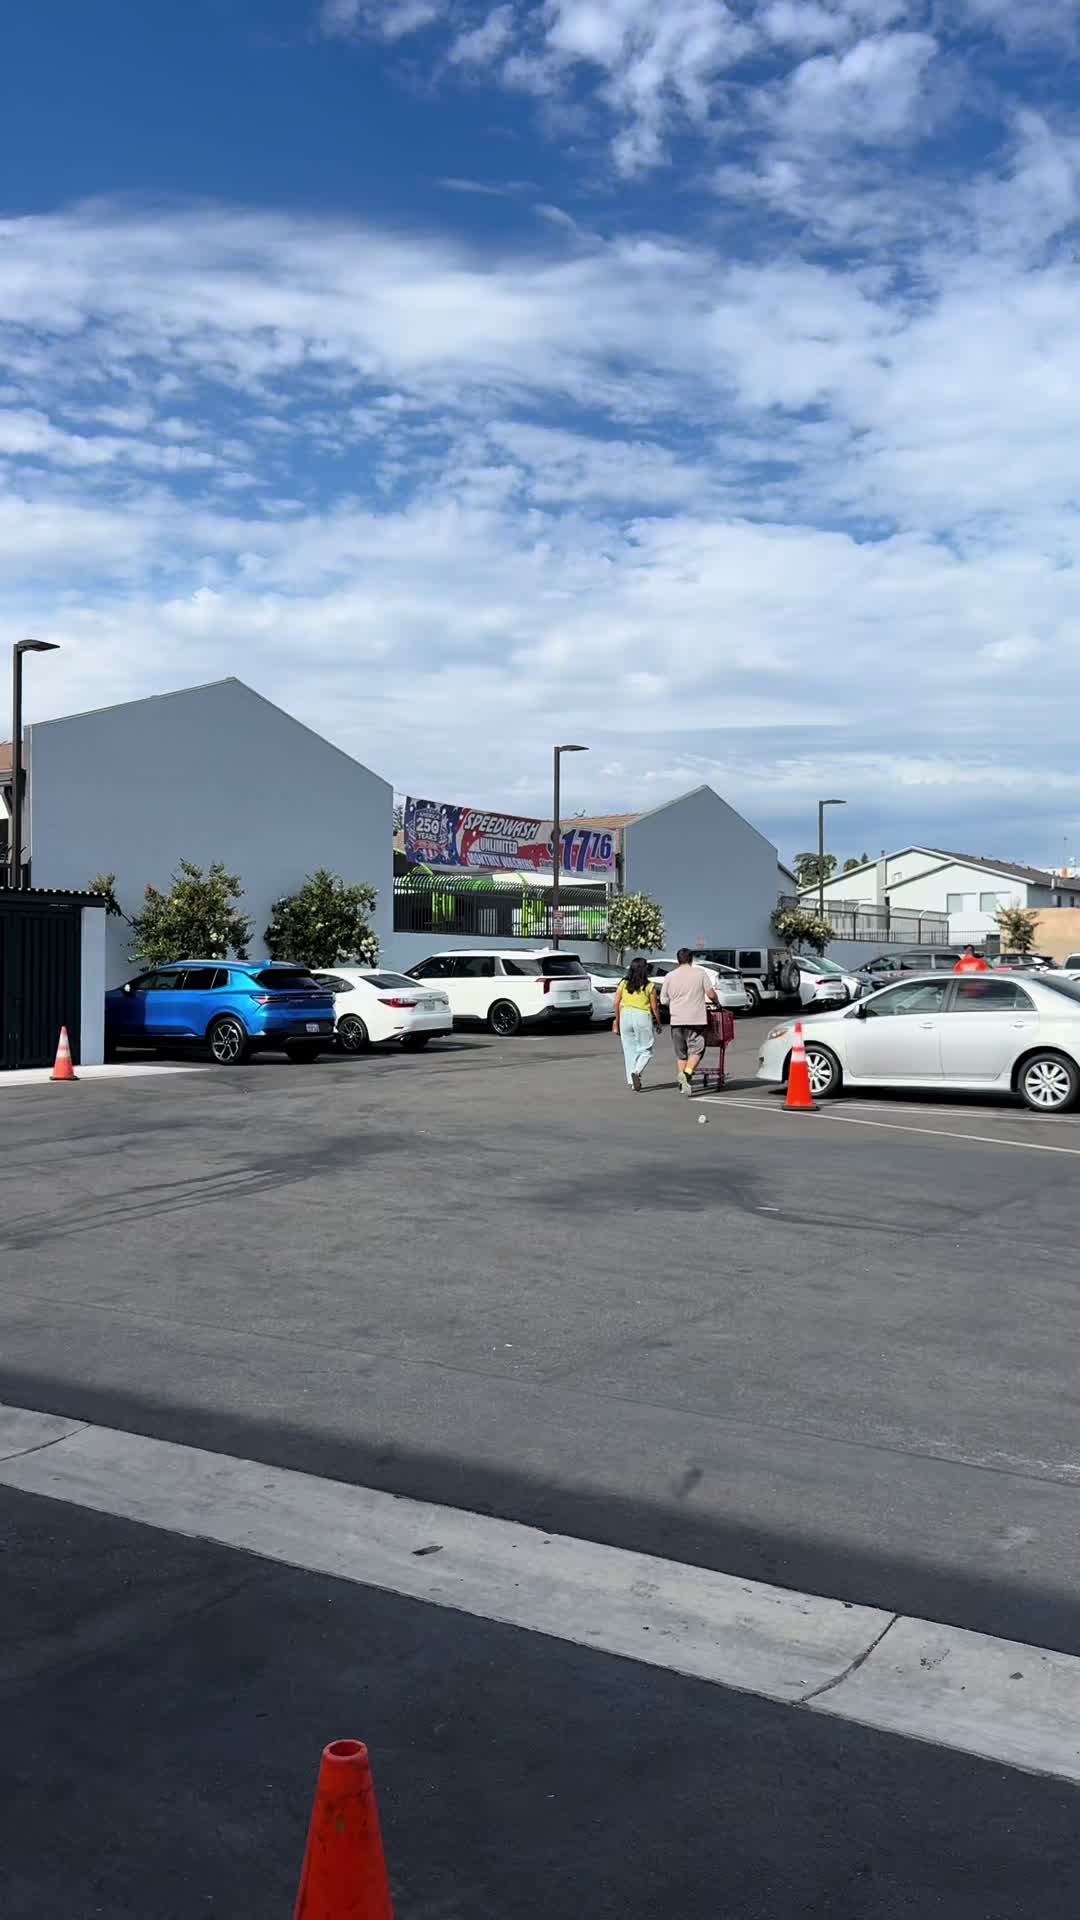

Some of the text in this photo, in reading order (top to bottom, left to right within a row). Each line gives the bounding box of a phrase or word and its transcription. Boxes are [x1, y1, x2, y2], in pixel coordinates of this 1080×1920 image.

[416, 817, 439, 834] 250
[464, 813, 540, 841] SPEEDWASH
[480, 837, 518, 855] UNLIMITED
